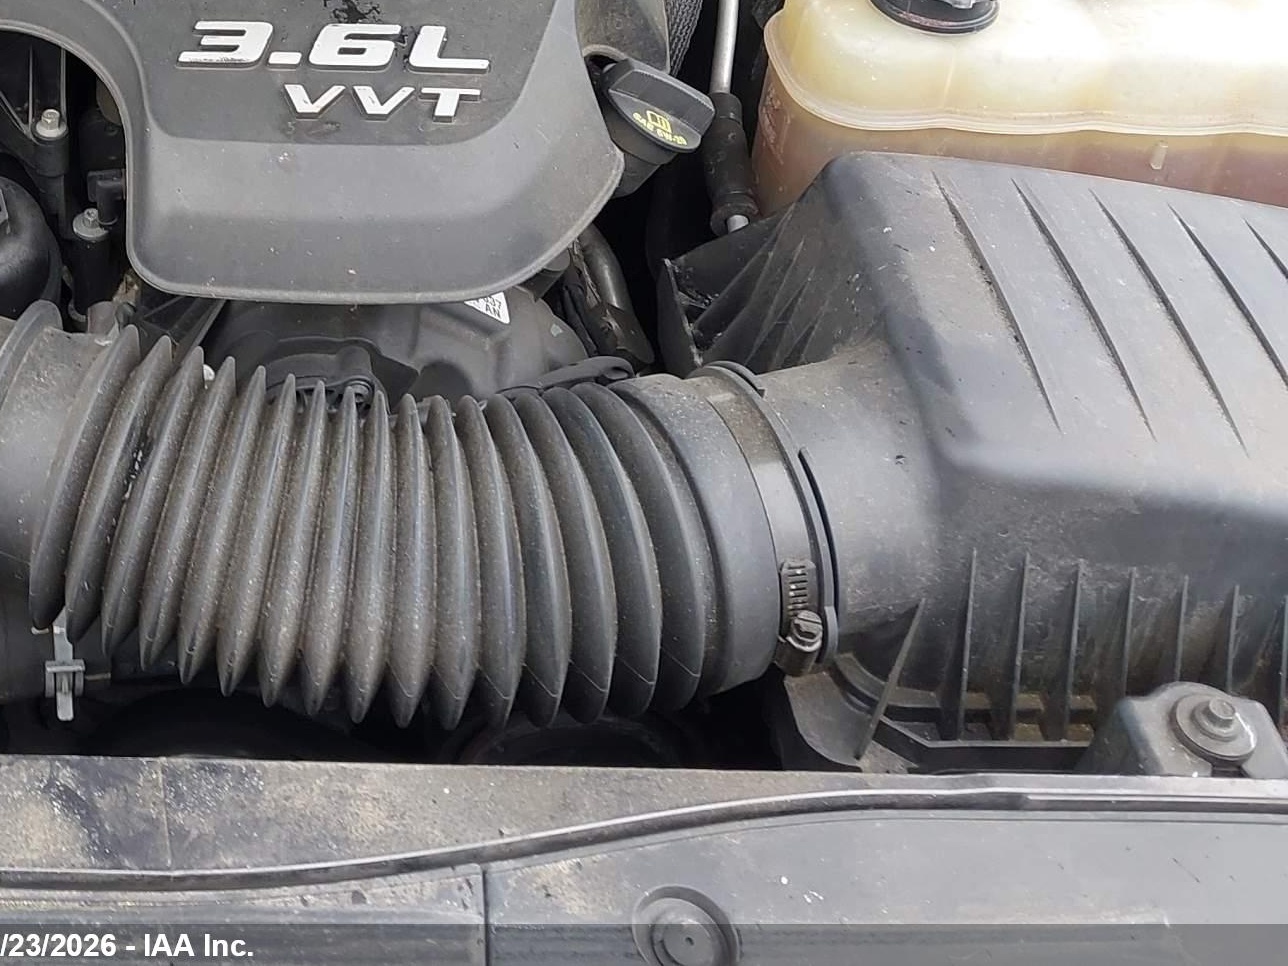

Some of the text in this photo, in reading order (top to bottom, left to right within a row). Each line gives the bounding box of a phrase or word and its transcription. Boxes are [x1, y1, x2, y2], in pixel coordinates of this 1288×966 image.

[176, 21, 491, 74] 3.6L
[283, 84, 482, 123] VVT
[632, 112, 655, 131] SAE
